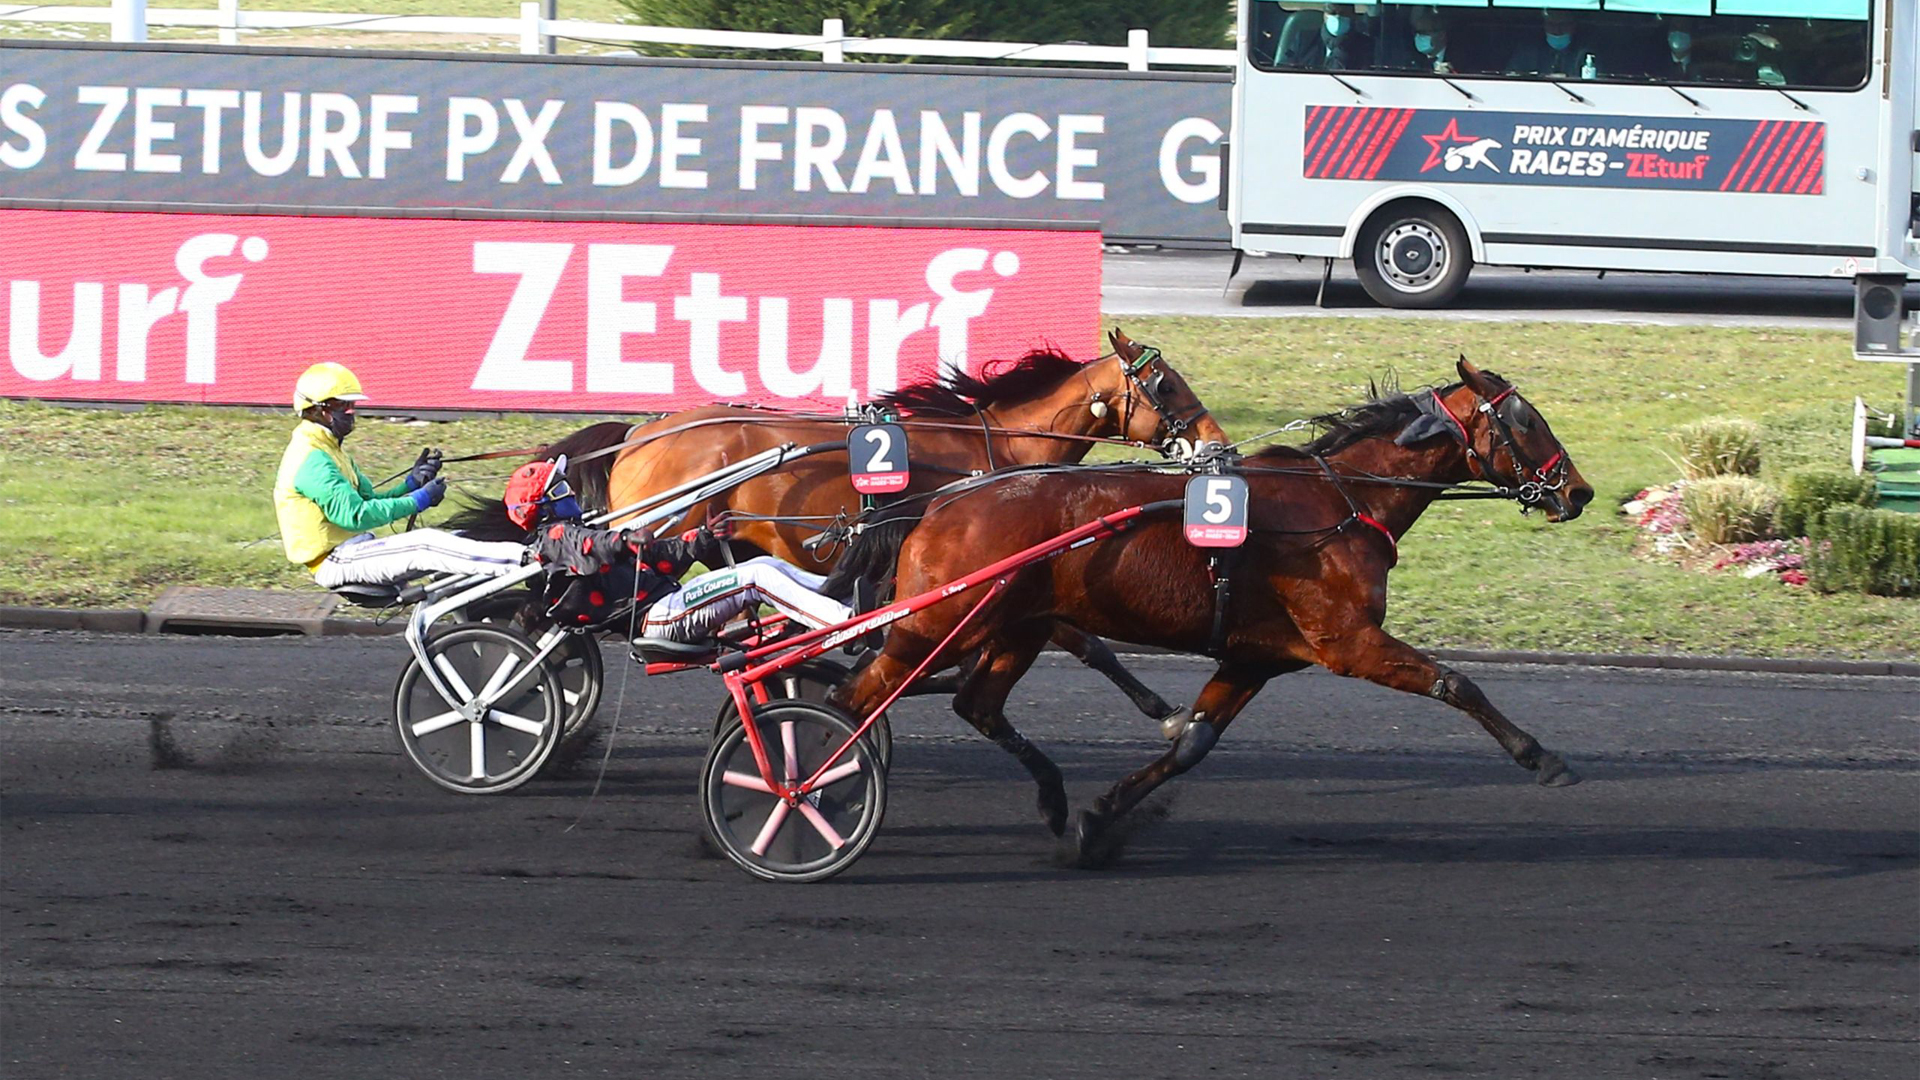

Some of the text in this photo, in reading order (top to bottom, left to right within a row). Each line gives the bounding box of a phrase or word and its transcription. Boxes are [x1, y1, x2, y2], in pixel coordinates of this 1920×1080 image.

[74, 86, 419, 179] ZETURF
[446, 97, 565, 185] PX
[592, 101, 708, 190] DE
[739, 105, 1105, 200] FRANCE
[1512, 124, 1710, 153] PRIX D'AMÉRIQUE
[470, 240, 1020, 398] ZEturf
[864, 428, 893, 473] 2
[1202, 479, 1233, 524] 5
[685, 576, 736, 603] Paris Courses
